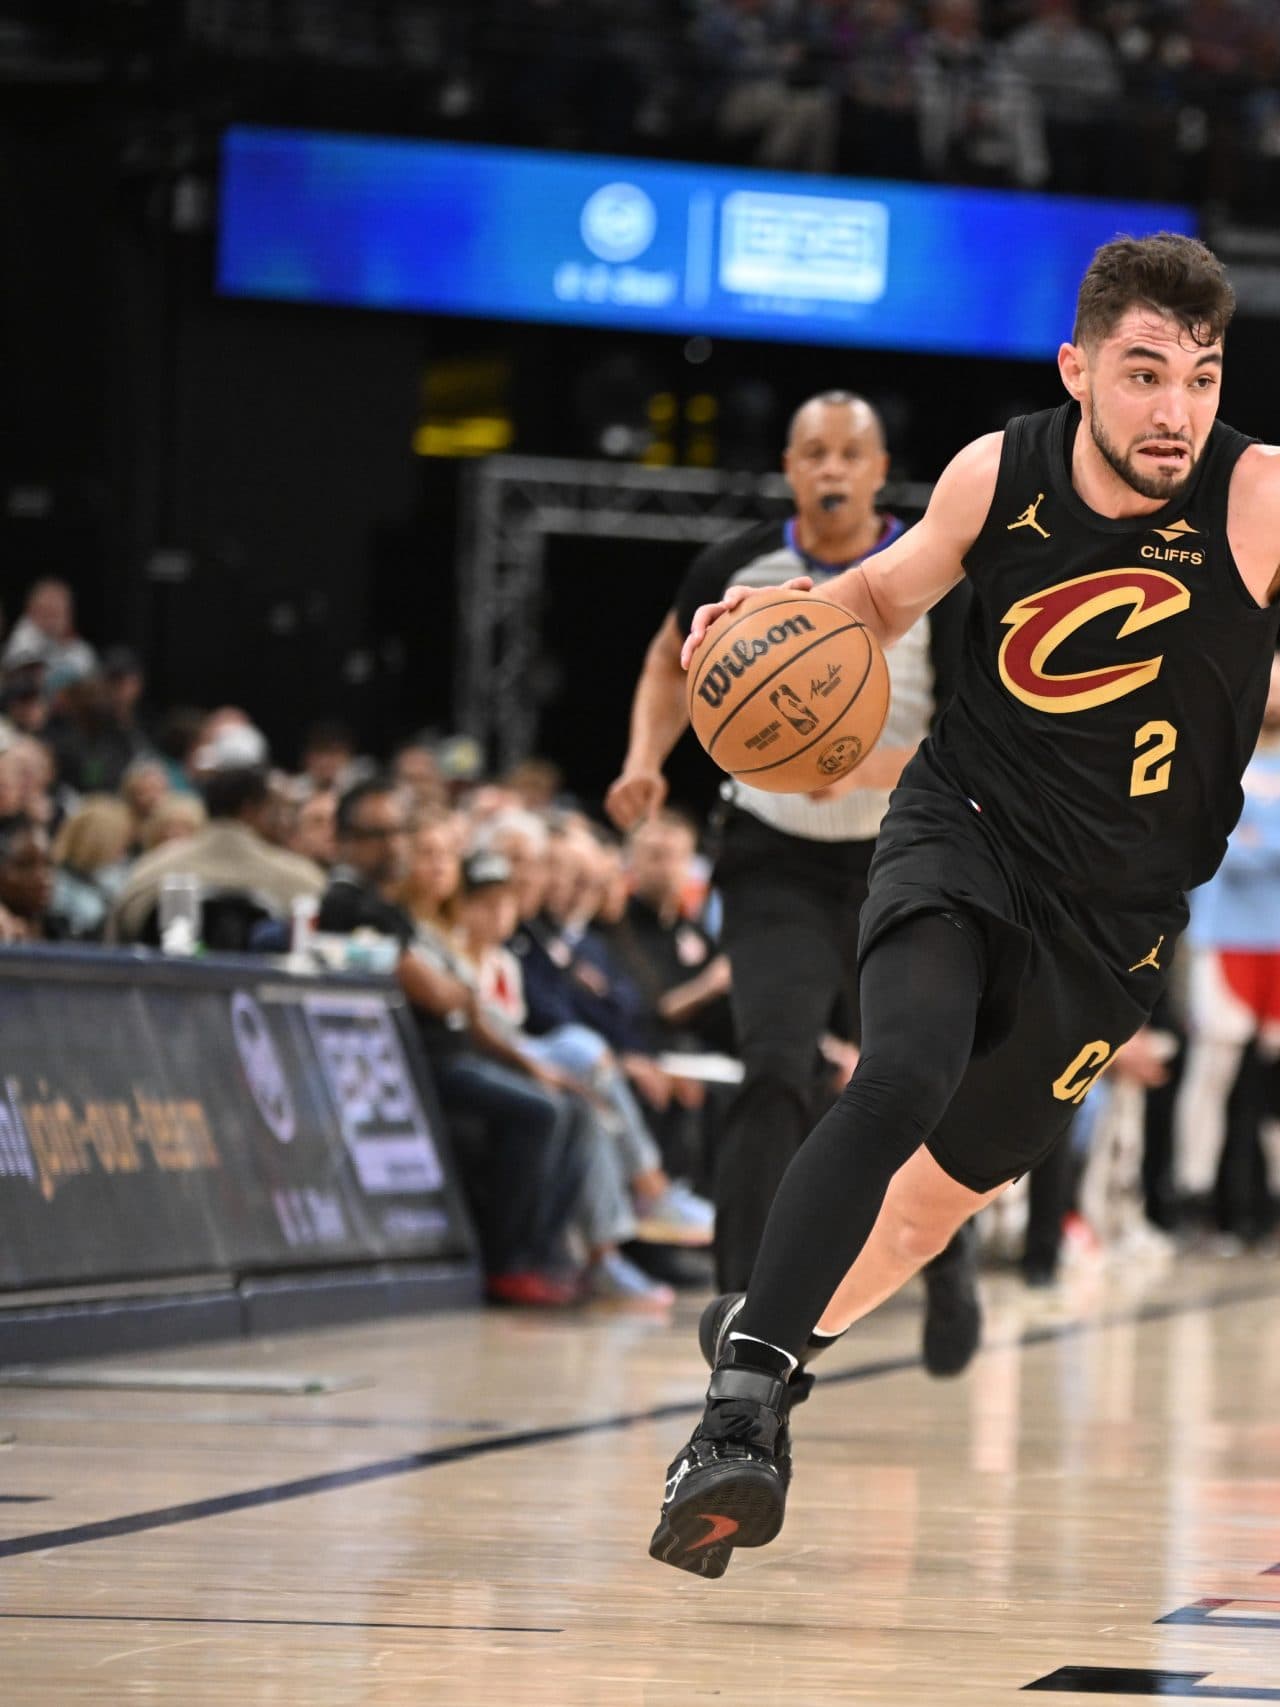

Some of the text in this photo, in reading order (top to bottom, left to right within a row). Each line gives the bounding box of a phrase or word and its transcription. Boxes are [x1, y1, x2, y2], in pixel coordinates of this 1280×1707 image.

[1140, 545, 1203, 565] CLIFFS
[698, 614, 816, 709] Wilson
[998, 567, 1191, 714] C
[1130, 720, 1178, 797] 2
